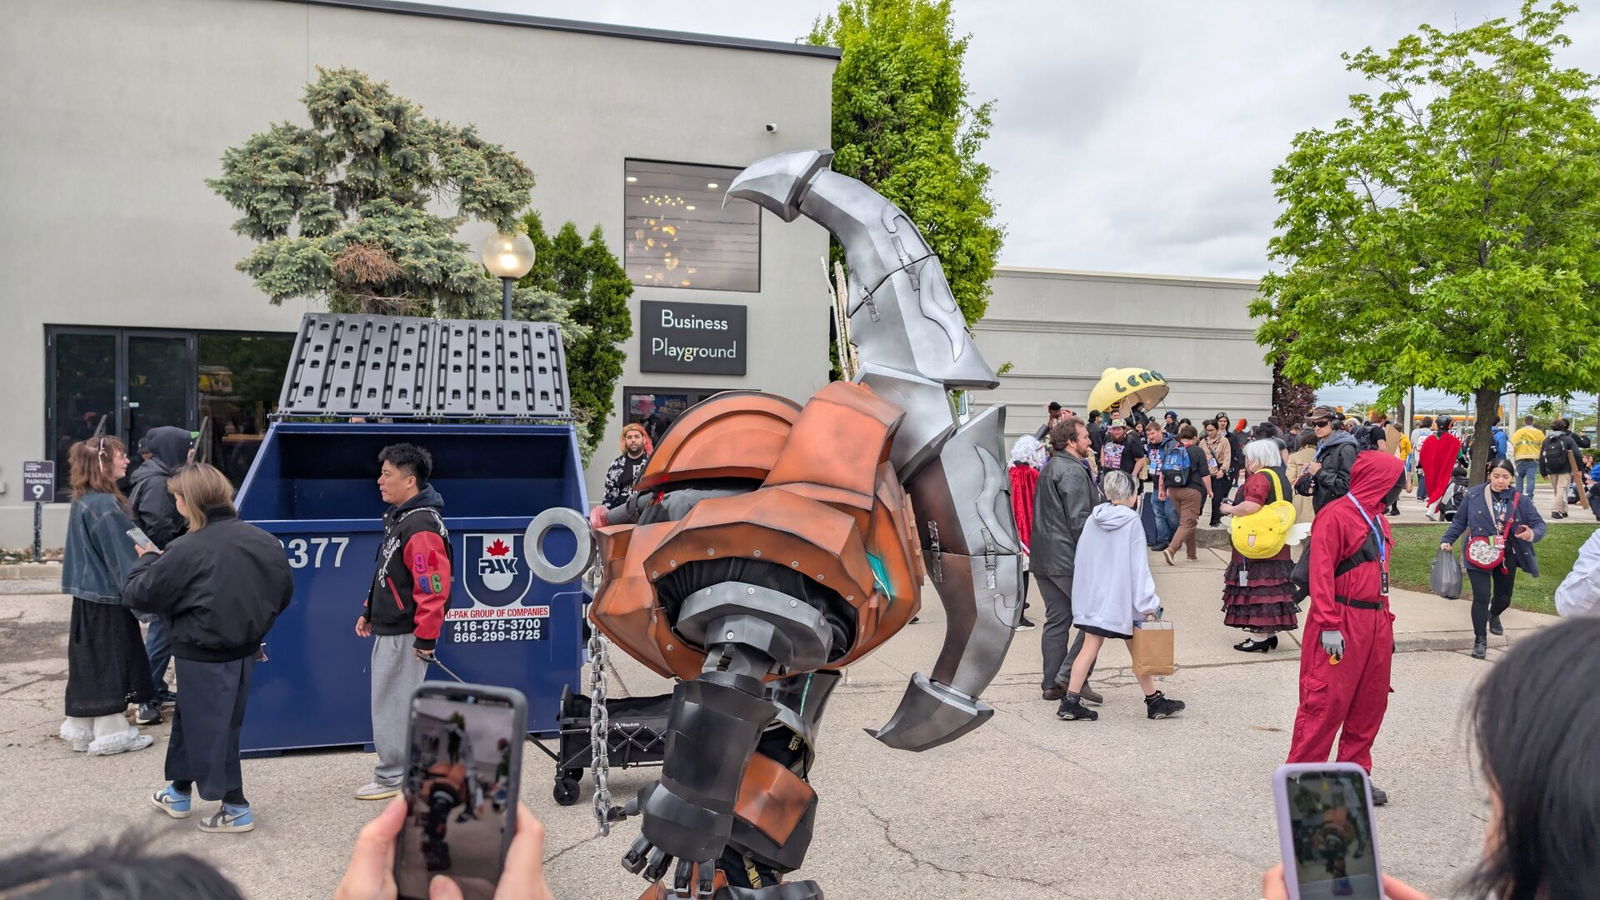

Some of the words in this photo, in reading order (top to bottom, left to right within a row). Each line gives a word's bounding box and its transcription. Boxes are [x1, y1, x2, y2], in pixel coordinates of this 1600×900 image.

[661, 308, 728, 330] Business
[652, 337, 736, 362] Playground
[32, 484, 45, 499] 9
[278, 536, 350, 569] 377
[478, 557, 519, 575] PAK
[470, 608, 495, 618] GROUP
[496, 608, 506, 617] OF
[507, 606, 549, 617] COMPANIES
[453, 619, 541, 631] 416-675-3700
[453, 630, 541, 643] 866-299-8725
